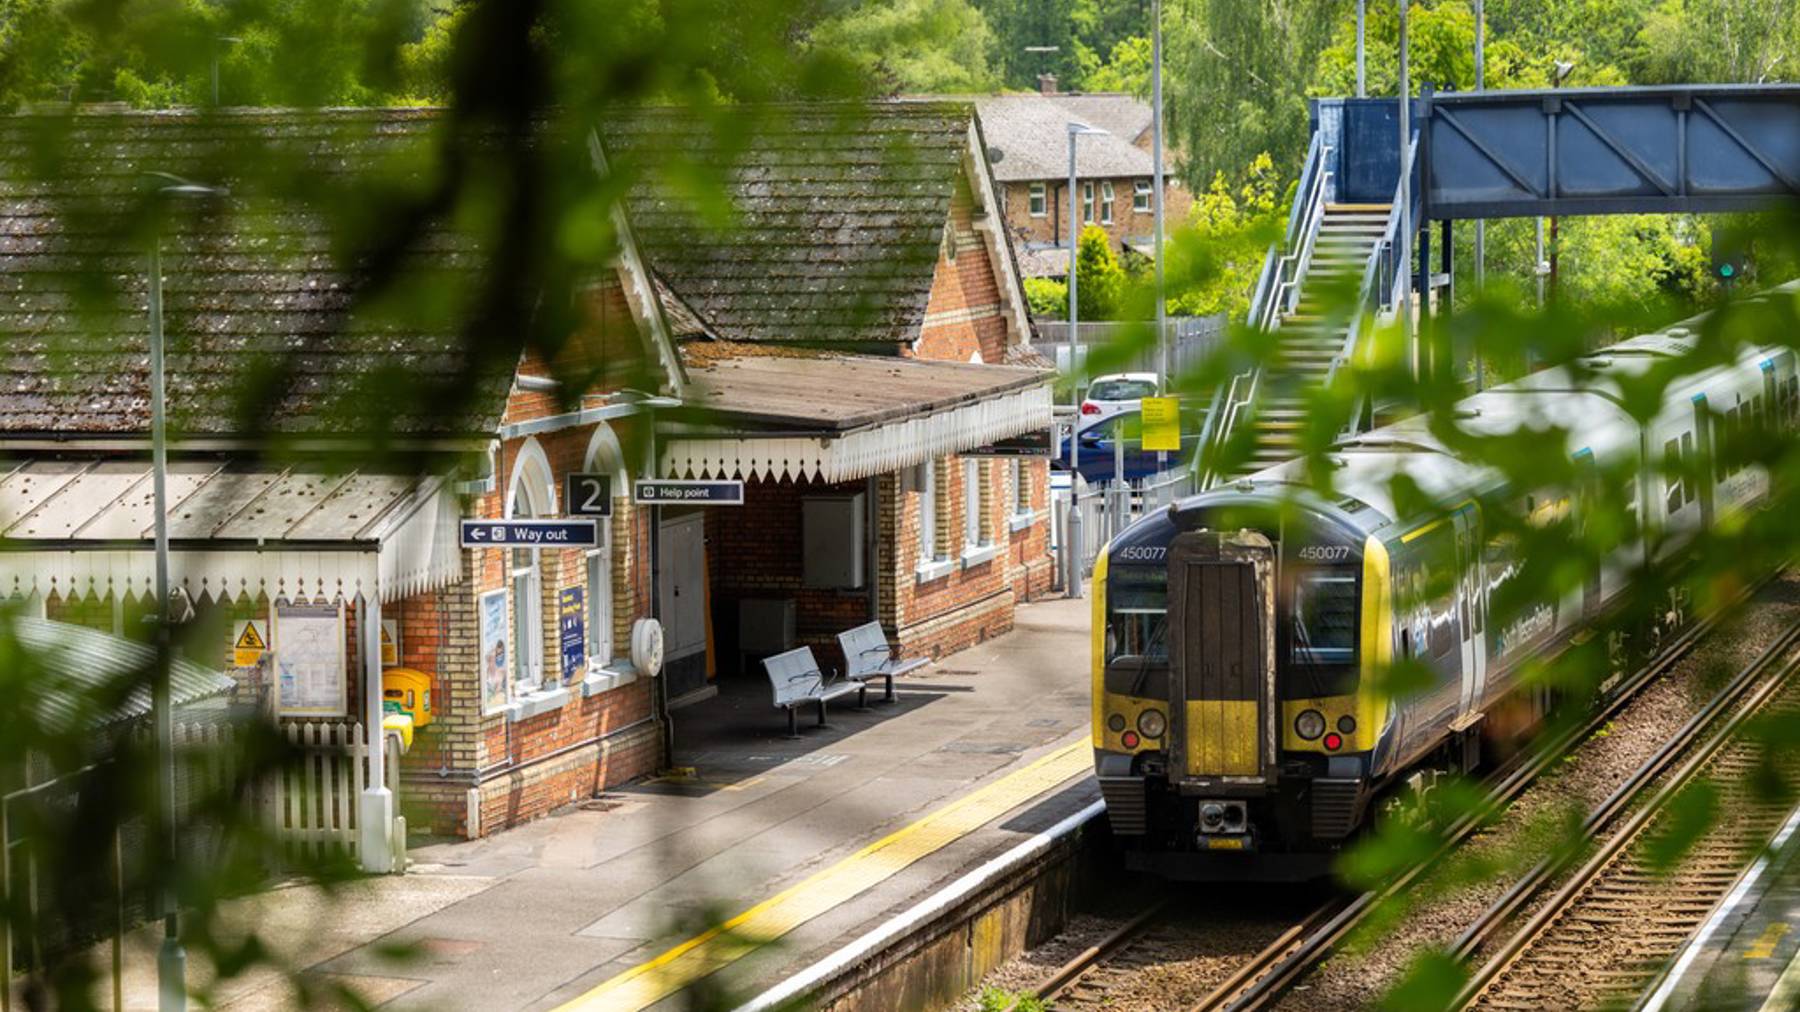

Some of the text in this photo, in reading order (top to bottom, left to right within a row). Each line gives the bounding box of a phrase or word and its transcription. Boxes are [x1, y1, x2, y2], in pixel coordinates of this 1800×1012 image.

[581, 478, 602, 512] 2
[660, 487, 710, 499] Help point
[514, 527, 568, 543] Way out
[1120, 546, 1167, 560] 450077
[1298, 545, 1349, 560] 450077
